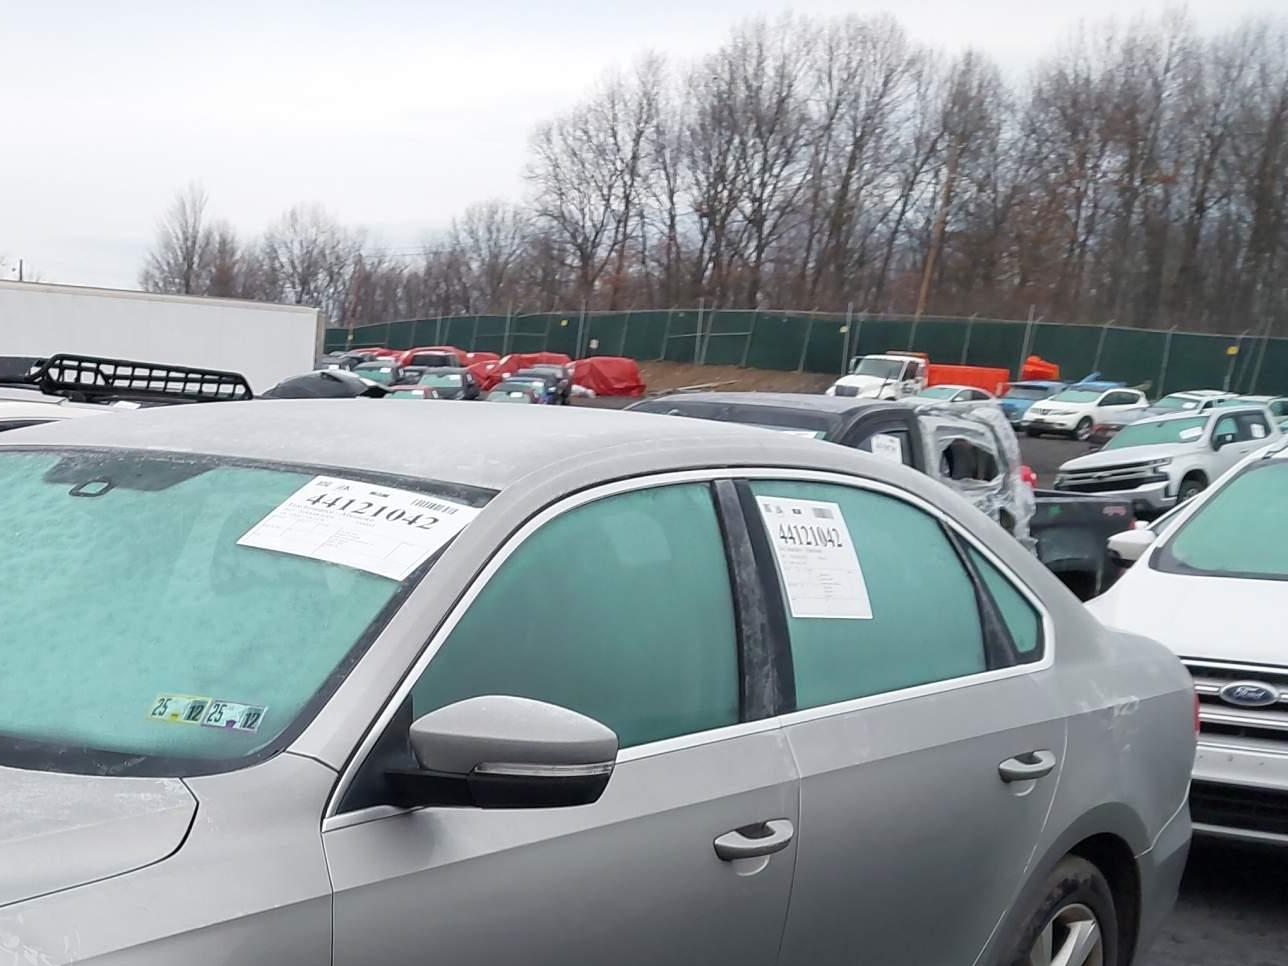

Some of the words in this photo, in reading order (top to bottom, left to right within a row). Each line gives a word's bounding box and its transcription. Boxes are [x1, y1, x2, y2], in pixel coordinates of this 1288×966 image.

[306, 493, 439, 530] 44121042
[779, 524, 842, 547] 44121042
[151, 698, 172, 717] 25
[186, 704, 204, 721] 12
[207, 703, 228, 723] 25
[242, 712, 261, 730] 12
